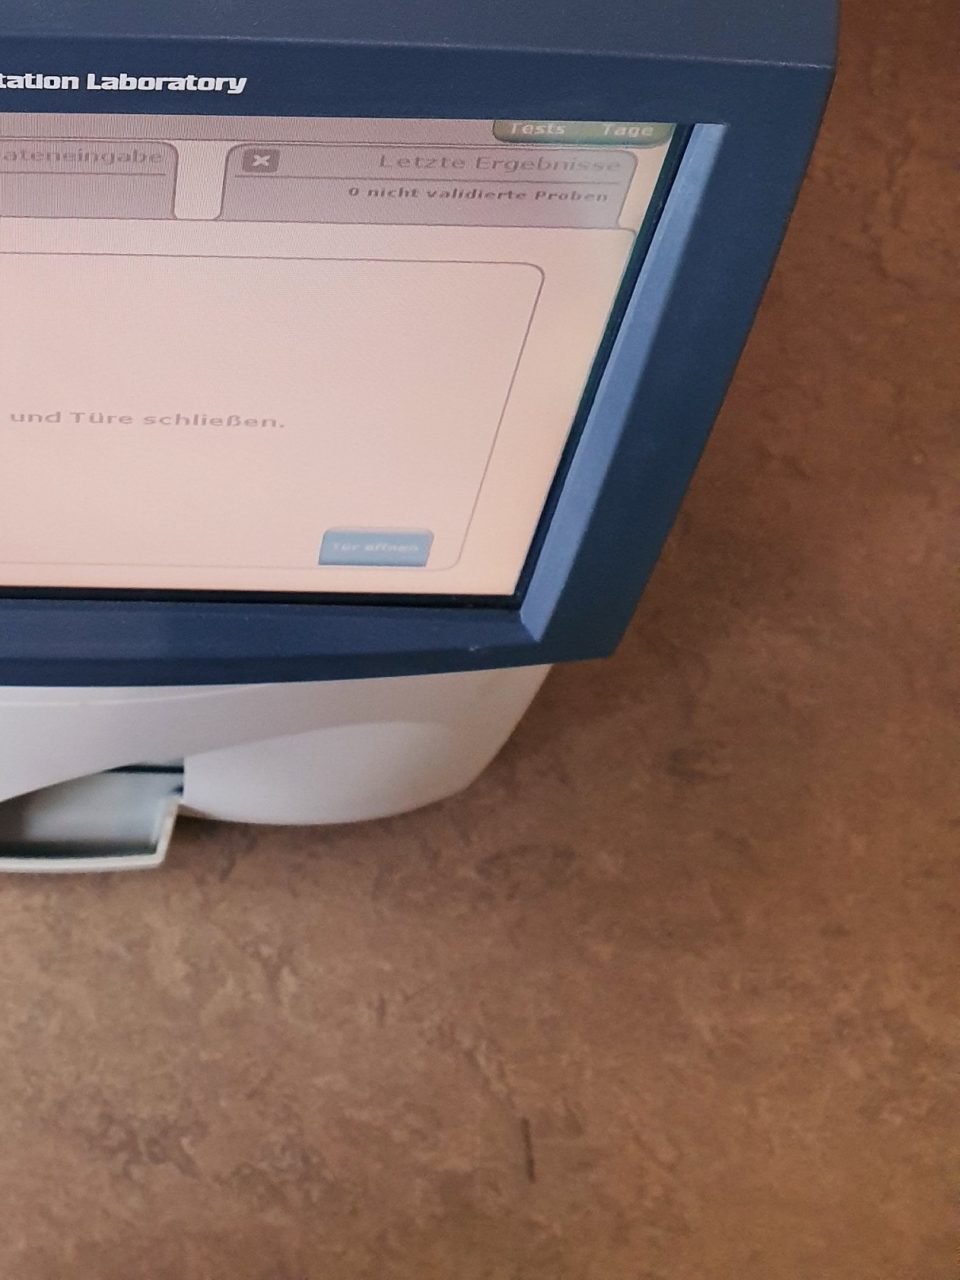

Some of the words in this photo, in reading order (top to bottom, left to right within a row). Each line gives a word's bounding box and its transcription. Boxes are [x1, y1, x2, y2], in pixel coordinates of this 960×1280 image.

[86, 73, 247, 94] Laboratory
[510, 122, 566, 135] Tests
[603, 123, 654, 138] Tage
[379, 154, 466, 170] Letzte
[476, 156, 622, 173] Ergebnisse
[367, 187, 419, 199] nicht
[427, 188, 527, 201] validierte
[535, 190, 609, 202] Proben
[10, 411, 62, 424] und
[69, 411, 134, 425] Türe
[143, 412, 286, 429] schließen.
